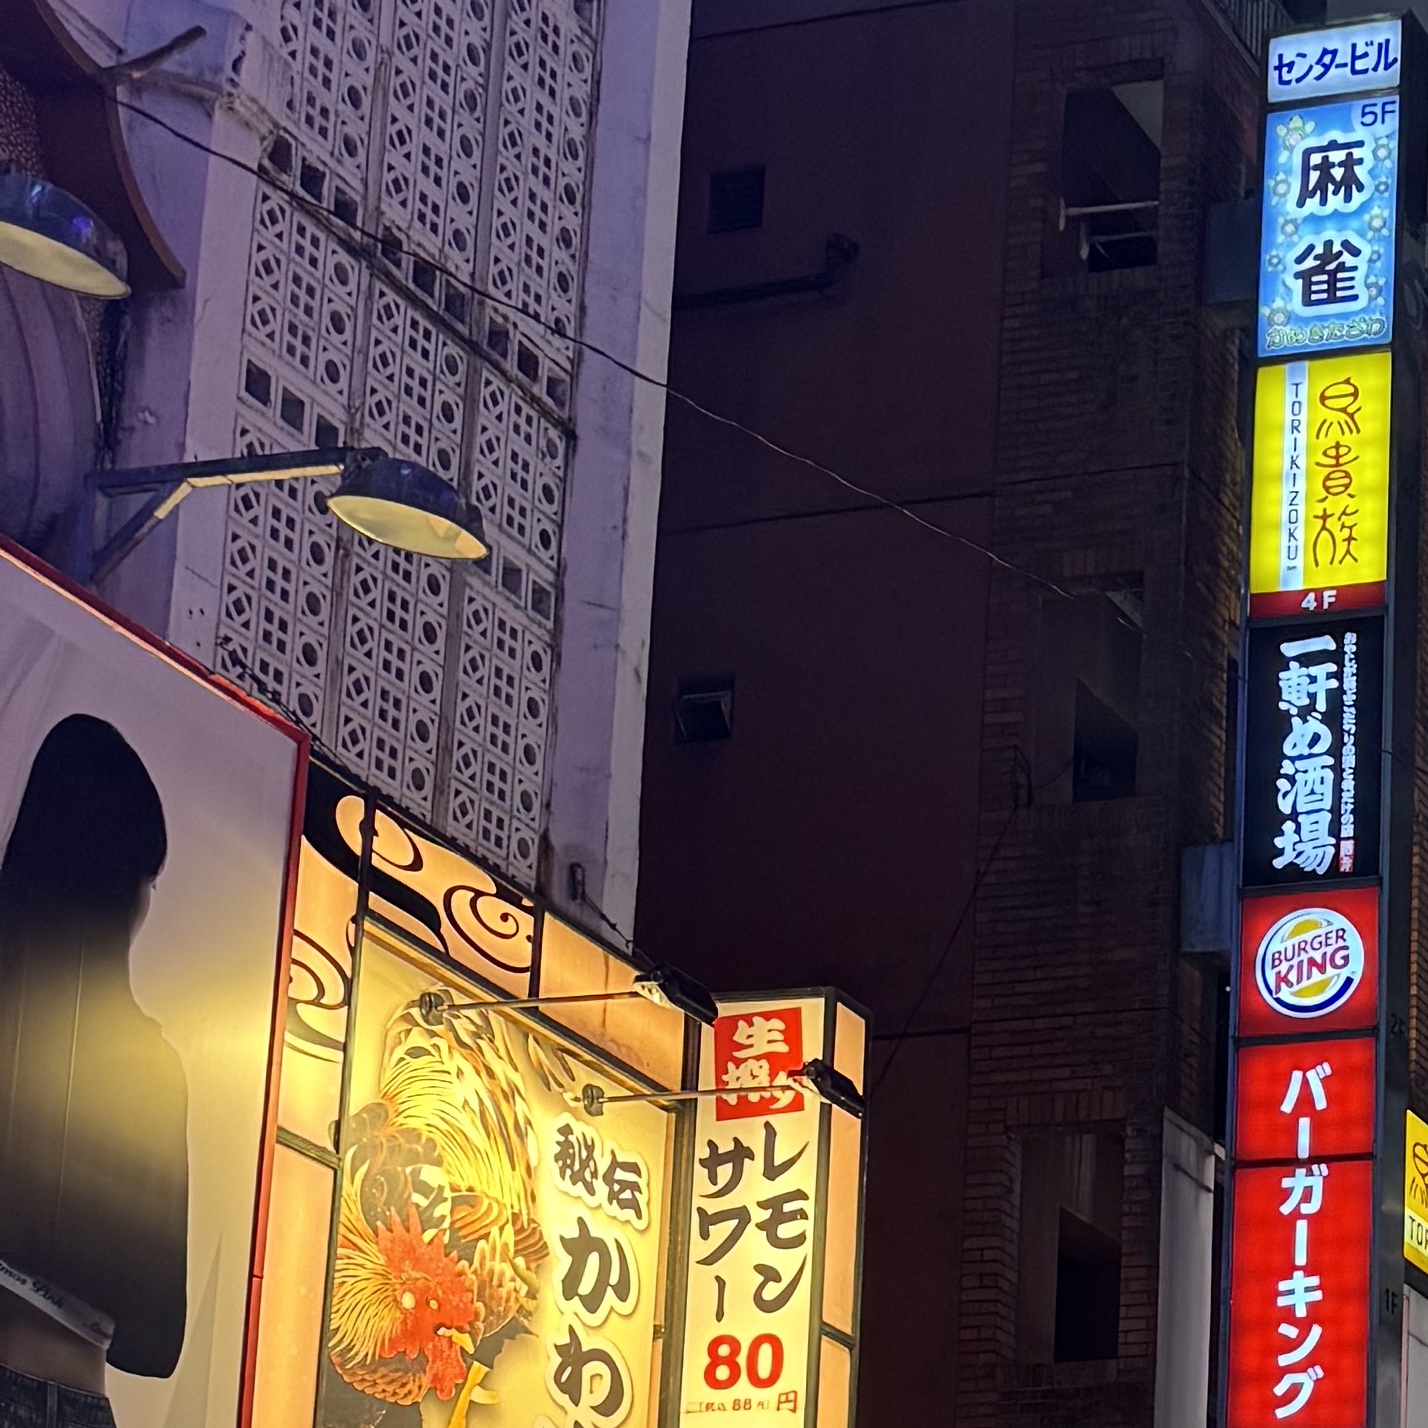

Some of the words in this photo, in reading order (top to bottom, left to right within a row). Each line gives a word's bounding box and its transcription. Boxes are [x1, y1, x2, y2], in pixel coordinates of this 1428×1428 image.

[1273, 39, 1399, 87] センタービル
[1360, 103, 1397, 127] 5F
[1293, 139, 1366, 307] 麻雀
[1284, 382, 1302, 563] TORIKIZOKU
[1311, 377, 1362, 569] 鳥貴族
[1301, 589, 1337, 611] 4F
[1272, 634, 1339, 876] 一軒め酒場
[1271, 927, 1347, 969] BURGER
[1273, 946, 1351, 997] KING
[553, 1122, 646, 1222] 秘伝
[753, 1121, 812, 1314] レモン
[697, 1137, 755, 1323] サワー
[1272, 1061, 1332, 1420] バーガーキング
[703, 1333, 785, 1390] 80
[776, 1390, 798, 1414] 円
